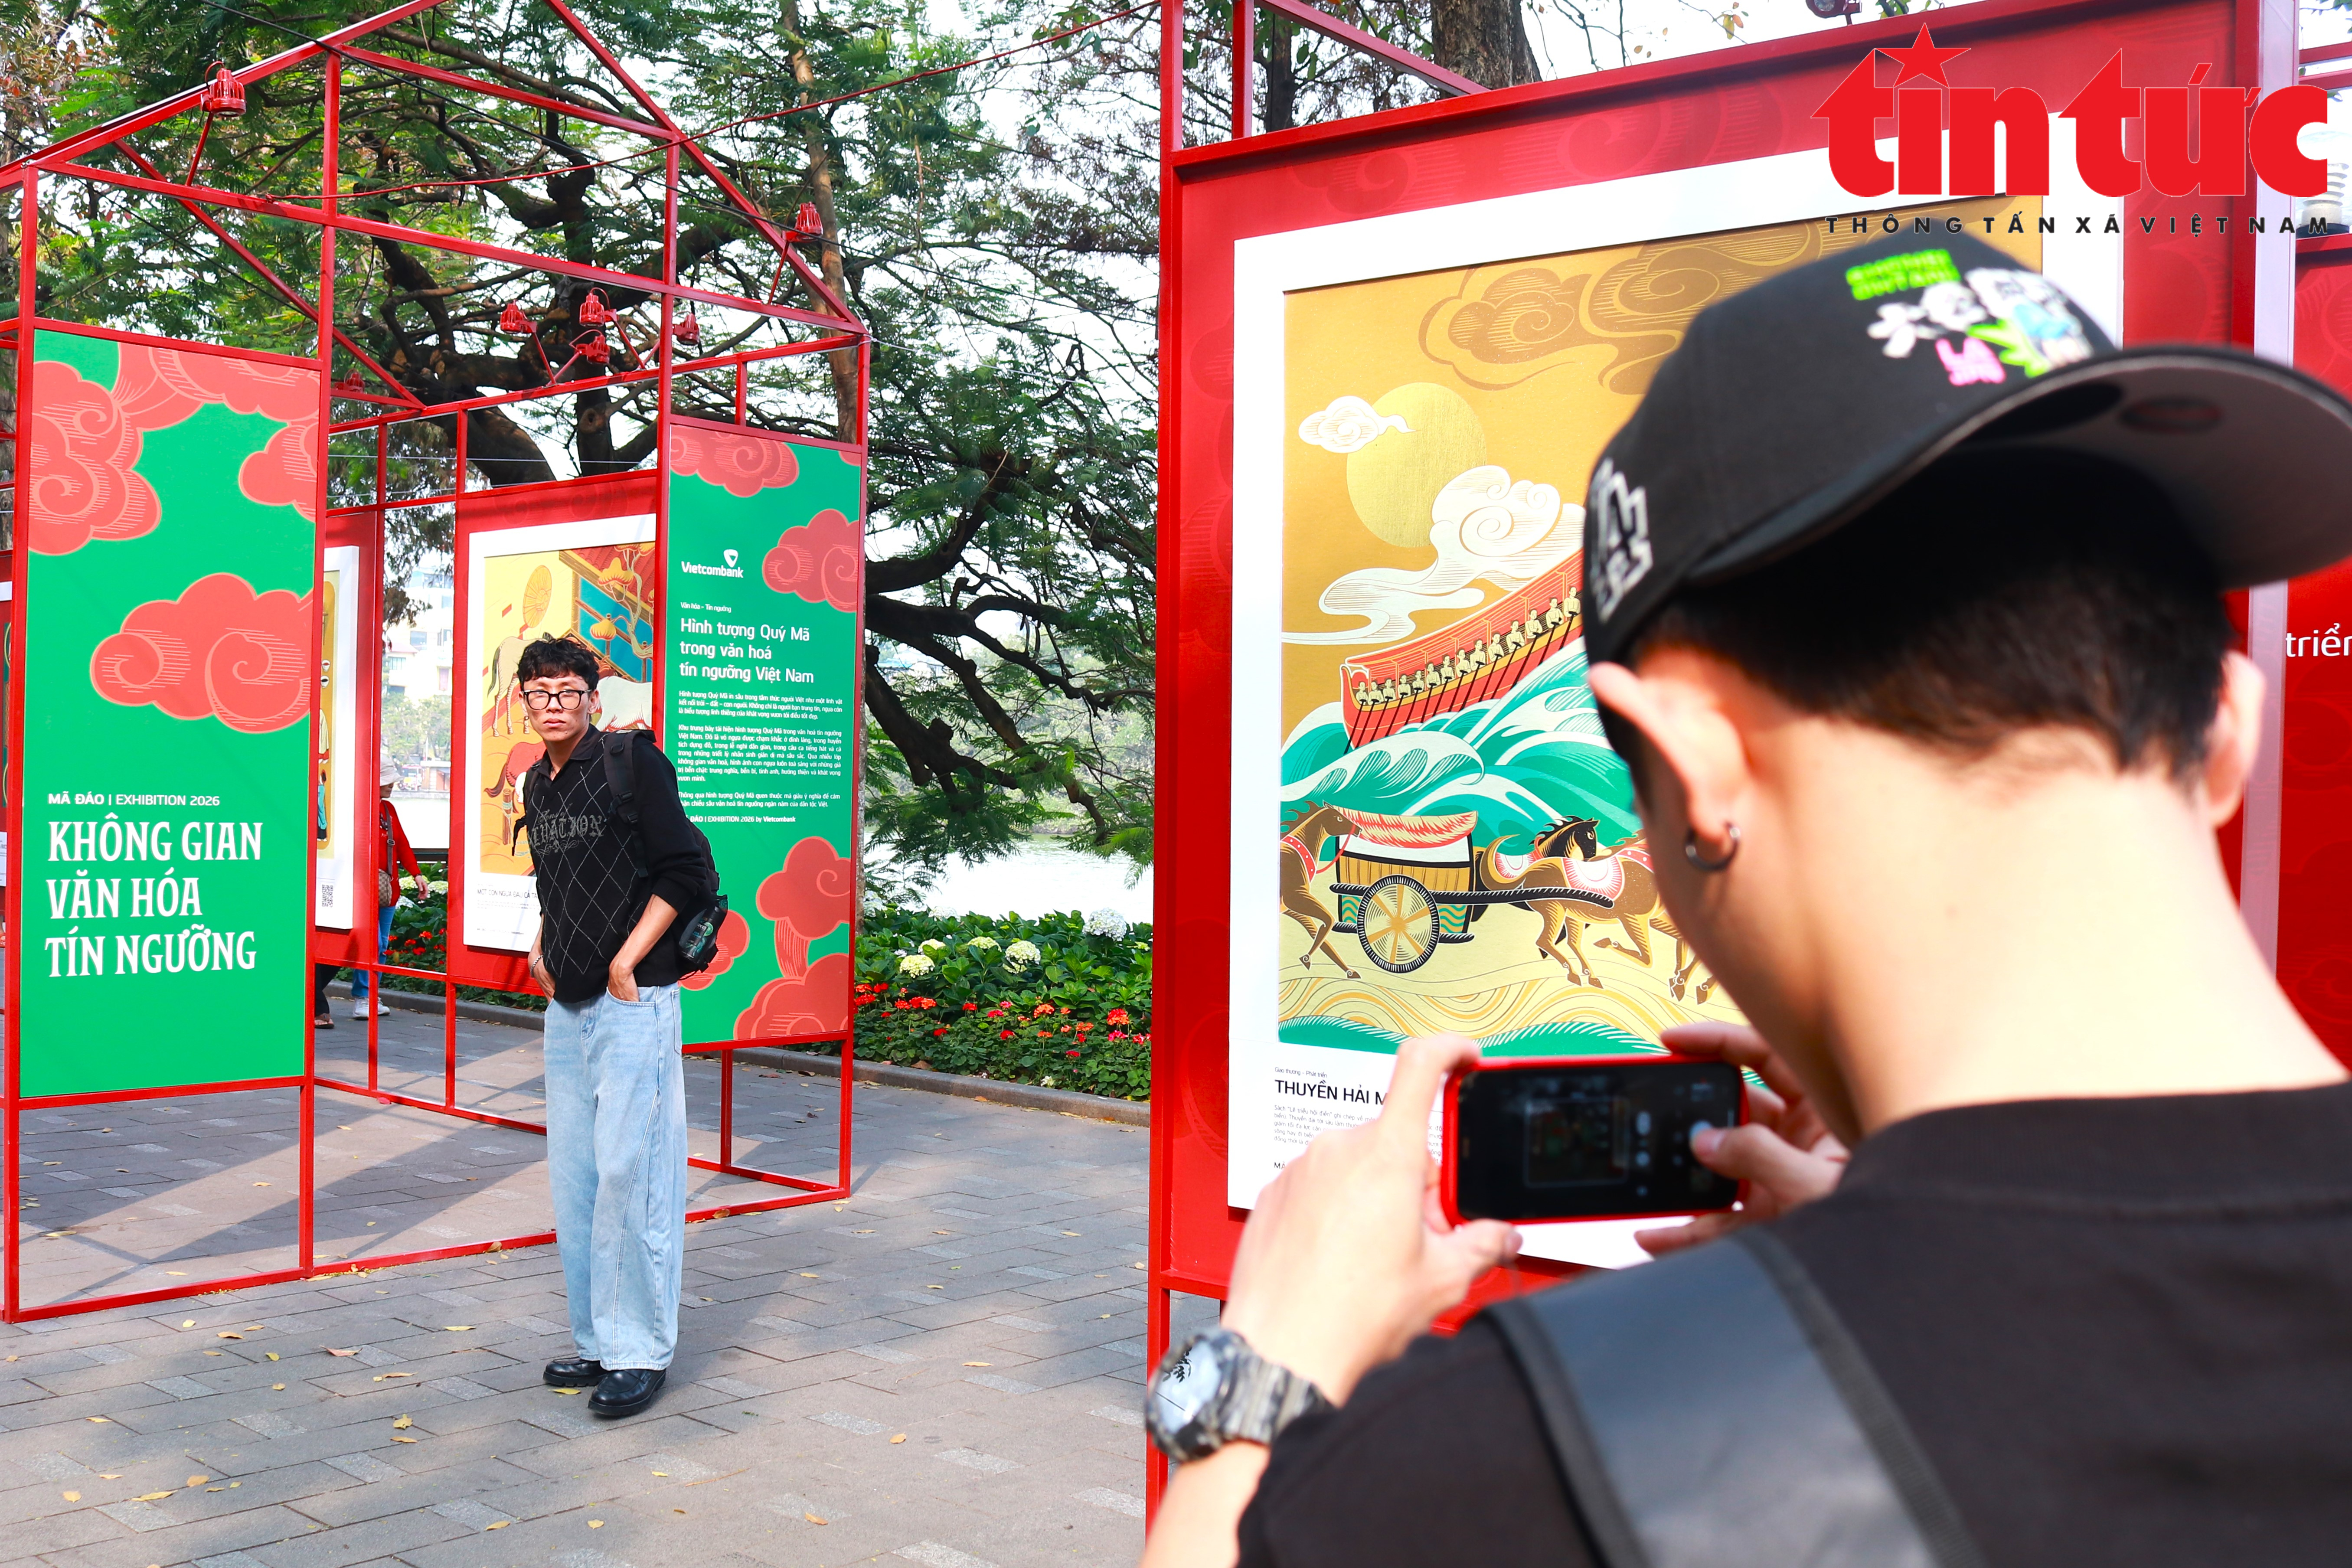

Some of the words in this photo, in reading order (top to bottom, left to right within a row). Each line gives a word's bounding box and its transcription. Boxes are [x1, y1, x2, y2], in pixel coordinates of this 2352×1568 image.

[681, 561, 744, 578] Vietcombank
[681, 617, 713, 634] Hình
[717, 622, 755, 640] tượng
[760, 624, 786, 642] Quý
[791, 626, 810, 641] Mã
[680, 641, 716, 660] trong
[720, 643, 744, 658] văn
[748, 644, 772, 660] hoá
[679, 661, 698, 677] tín
[702, 664, 751, 683] ngưỡng
[756, 666, 781, 684] Việt
[785, 668, 814, 683] Nam
[708, 691, 719, 700] Quý
[762, 727, 774, 735] Quý
[677, 758, 694, 766] không
[48, 791, 72, 805] MÃ
[74, 791, 105, 805] ĐÁO
[115, 794, 186, 806] EXHIBITION
[189, 795, 221, 807] 2026
[678, 791, 694, 800] Thông
[689, 815, 704, 823] ĐÁO
[49, 812, 173, 862] KHÔNG
[181, 821, 263, 861] GIAN
[46, 869, 121, 920] VĂN
[131, 867, 203, 918] HÓA
[45, 925, 106, 978] TÍN
[115, 923, 257, 975] NGƯỠNG
[1274, 1079, 1337, 1100] THUYỀN
[1343, 1084, 1369, 1104] HẢI
